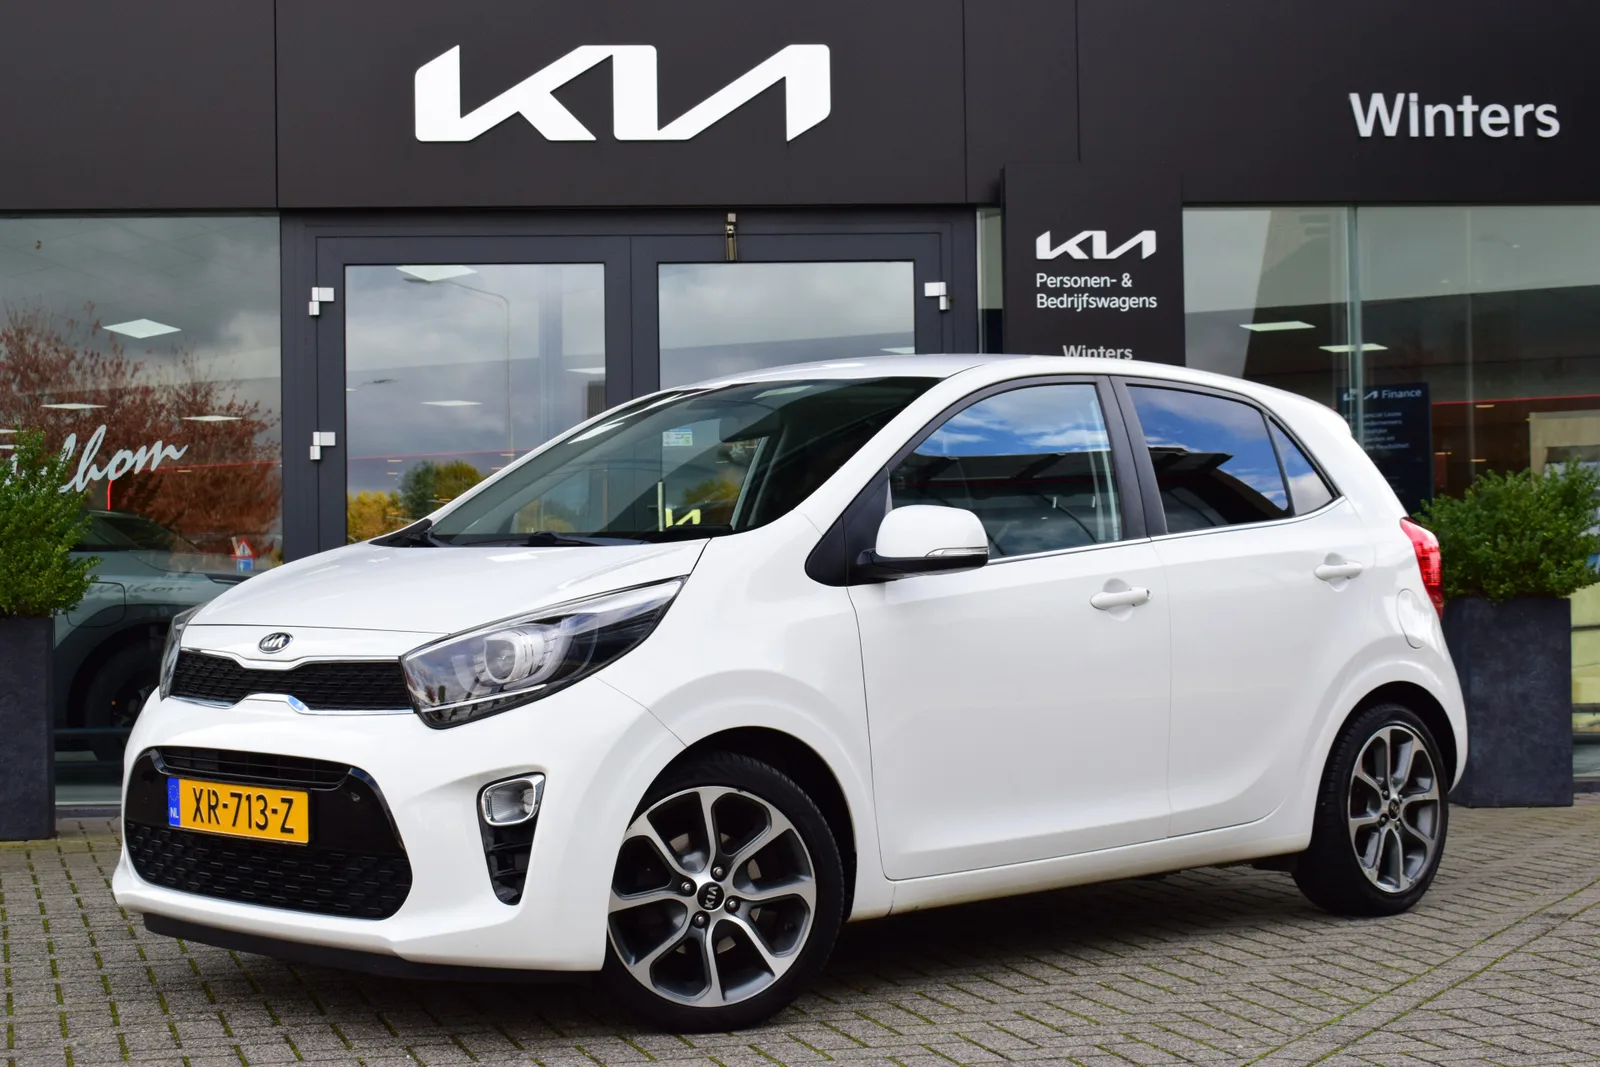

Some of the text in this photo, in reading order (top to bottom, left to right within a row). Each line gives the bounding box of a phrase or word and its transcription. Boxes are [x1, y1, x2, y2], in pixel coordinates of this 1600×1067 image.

[415, 44, 831, 142] KIA
[1349, 92, 1561, 138] Winters
[1036, 230, 1157, 260] KIA
[1036, 272, 1133, 288] Personen- &
[1036, 293, 1158, 312] Bedrijfswagens
[1062, 344, 1133, 360] Winters
[1382, 389, 1422, 399] Finance
[169, 786, 295, 834] NL XR-713-Z
[703, 886, 719, 909] KIA
